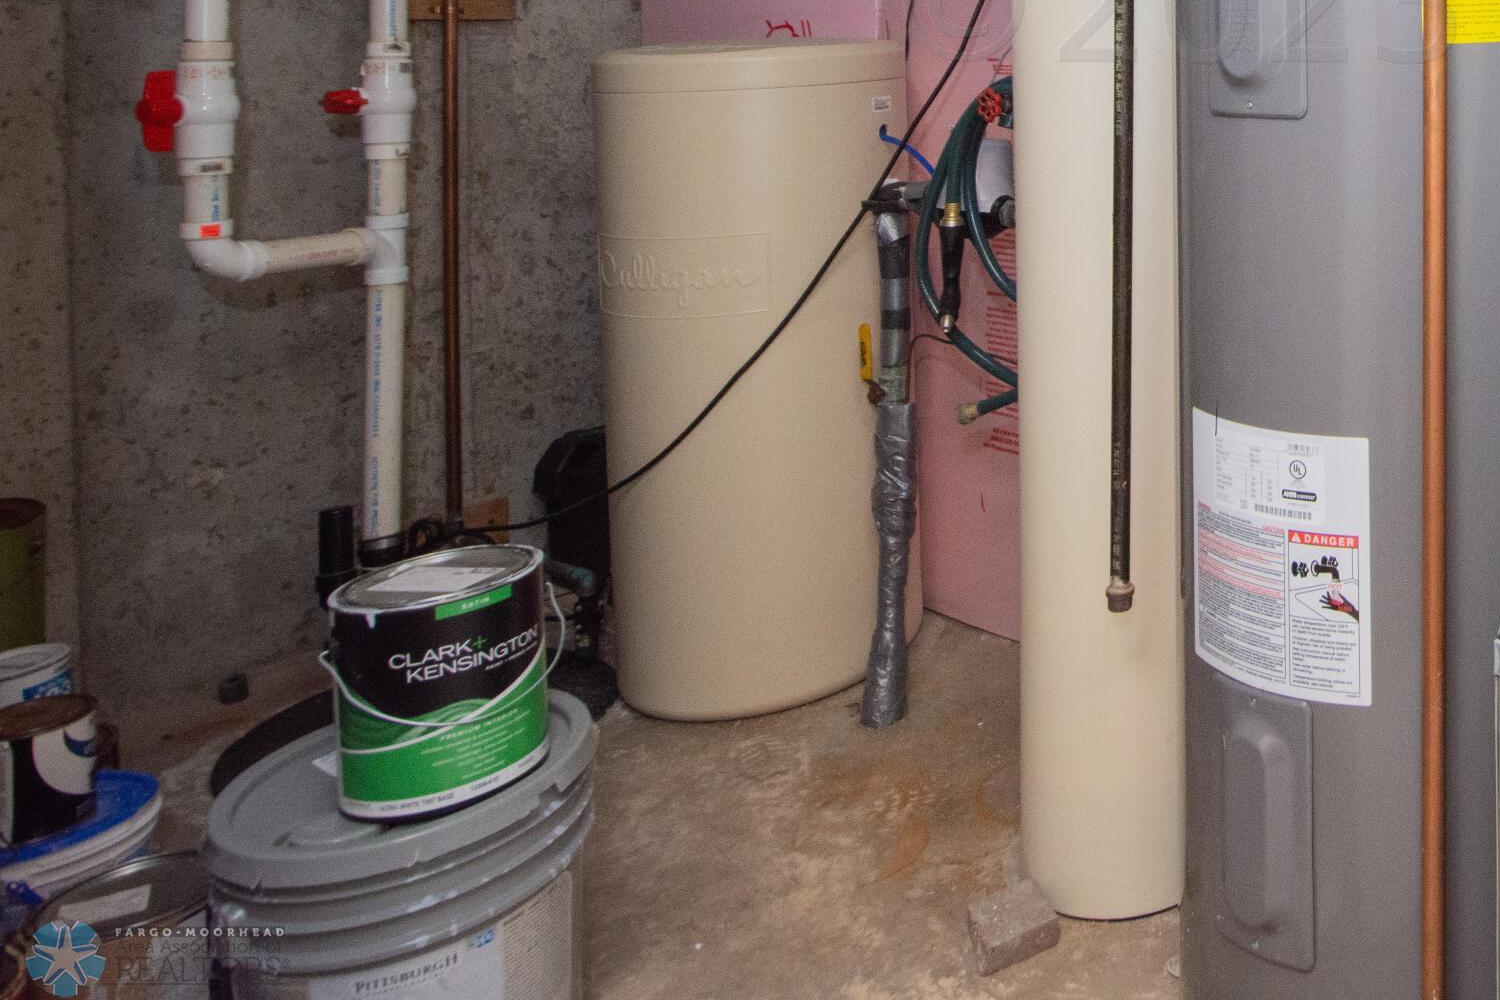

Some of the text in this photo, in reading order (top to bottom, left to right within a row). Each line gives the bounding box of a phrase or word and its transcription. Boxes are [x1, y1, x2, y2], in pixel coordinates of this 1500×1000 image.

[1304, 533, 1355, 548] DANGER
[406, 626, 538, 684] KENSINGTON
[355, 952, 459, 994] PITTSBURGH
